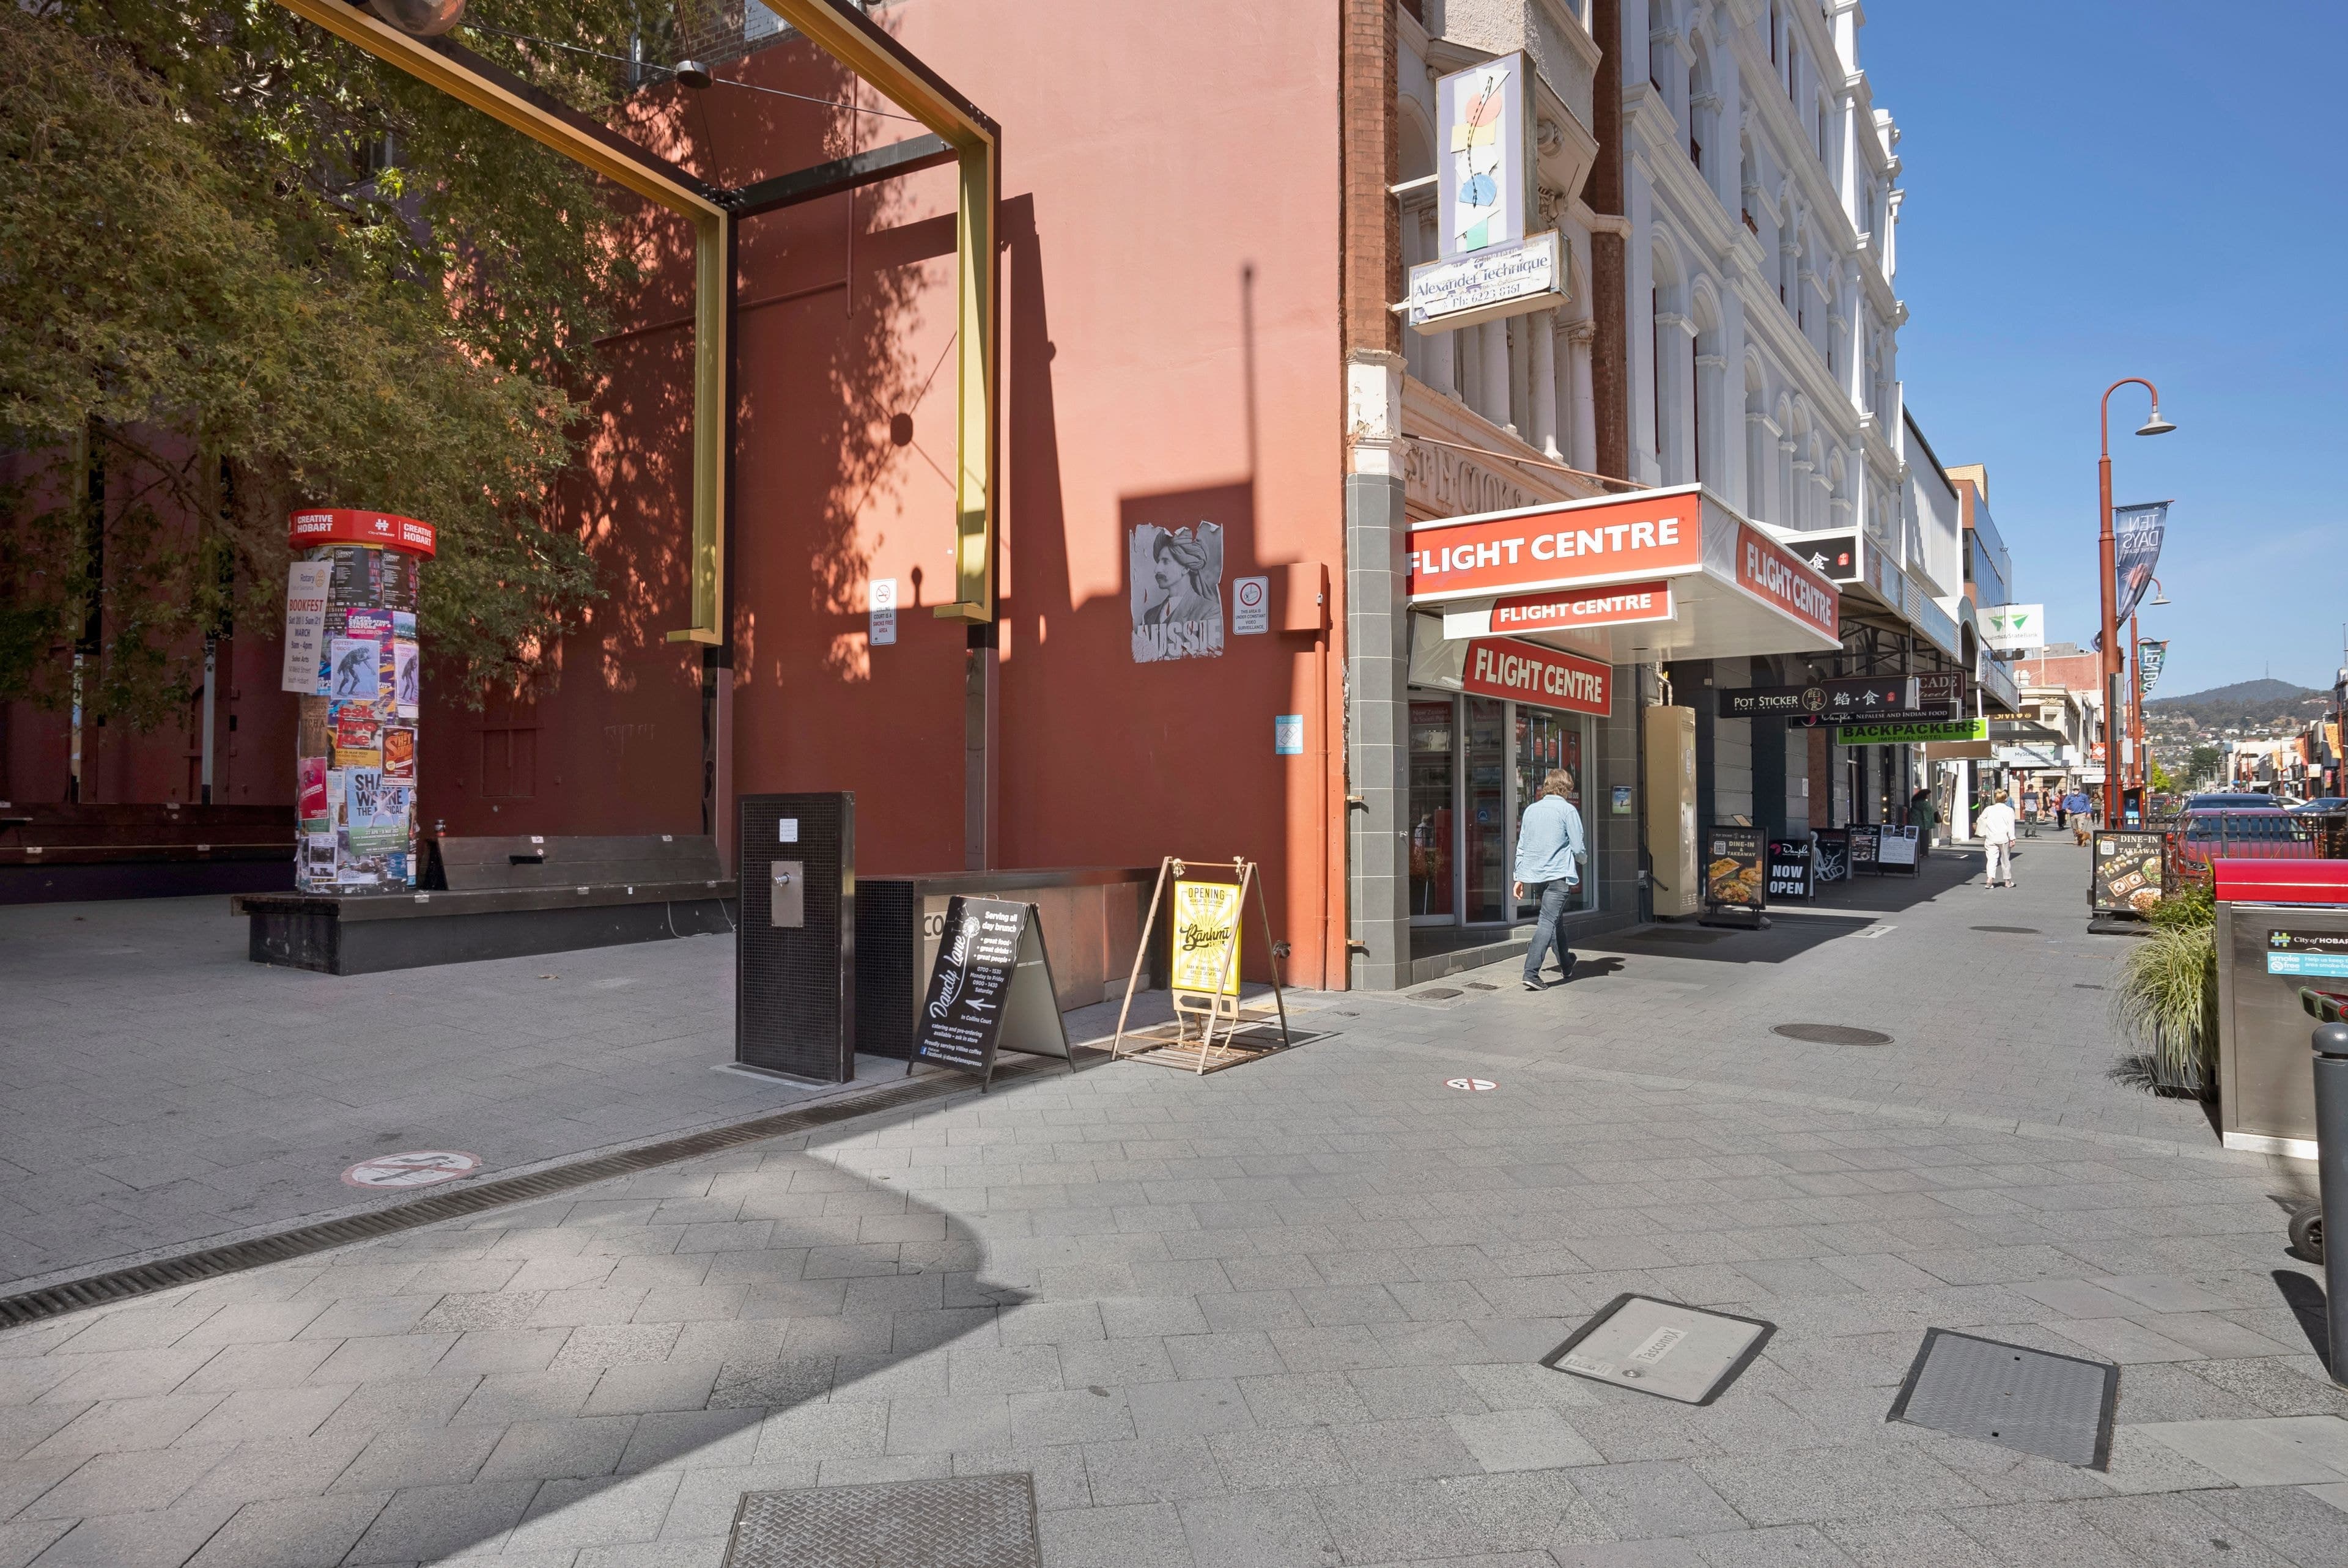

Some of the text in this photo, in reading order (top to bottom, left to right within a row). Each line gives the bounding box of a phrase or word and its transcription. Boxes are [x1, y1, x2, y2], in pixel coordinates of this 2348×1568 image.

[1414, 273, 1478, 297] Alexander
[1480, 257, 1548, 282] Technique
[298, 515, 333, 524] CREATIVE
[297, 523, 333, 534] HOBART
[404, 523, 432, 538] CREATIVE
[404, 531, 432, 547] HOBART
[1406, 517, 1680, 576] FLIGHT CENTRE
[300, 573, 314, 584] Rotary
[1746, 542, 1832, 628] FLIGHT CENTRE
[289, 599, 324, 612] BOOKFEST
[1500, 592, 1652, 623] FLIGHT CENTRE
[305, 616, 314, 625] Sun
[295, 628, 311, 637] MARCH
[1474, 648, 1603, 704] FLIGHT CENTRE
[1920, 676, 1957, 688] CADE
[1734, 696, 1798, 708] POT STICKER
[339, 705, 375, 719] esk
[1842, 721, 1981, 737] BACKPACKERS
[356, 790, 403, 806] WANE
[2129, 798, 2136, 808] P
[357, 806, 403, 816] THE SICAL
[1773, 864, 1803, 878] NOW
[1769, 881, 1804, 894] OPEN
[1188, 888, 1225, 900] OPENING
[984, 911, 1018, 922] Serving all
[981, 922, 1017, 933] day brunch
[997, 937, 1010, 946] food
[994, 946, 1010, 955] drinks
[991, 955, 1008, 963] people
[929, 935, 966, 1018] Dandy Lane
[970, 972, 986, 981] Monday
[992, 974, 1005, 983] Friday
[975, 987, 994, 996] Saturday
[965, 1015, 980, 1023] Collins
[931, 1023, 949, 1032] catering
[956, 1028, 983, 1038] pre-ordering
[924, 1039, 940, 1048] Proudly
[940, 1042, 955, 1051] serving
